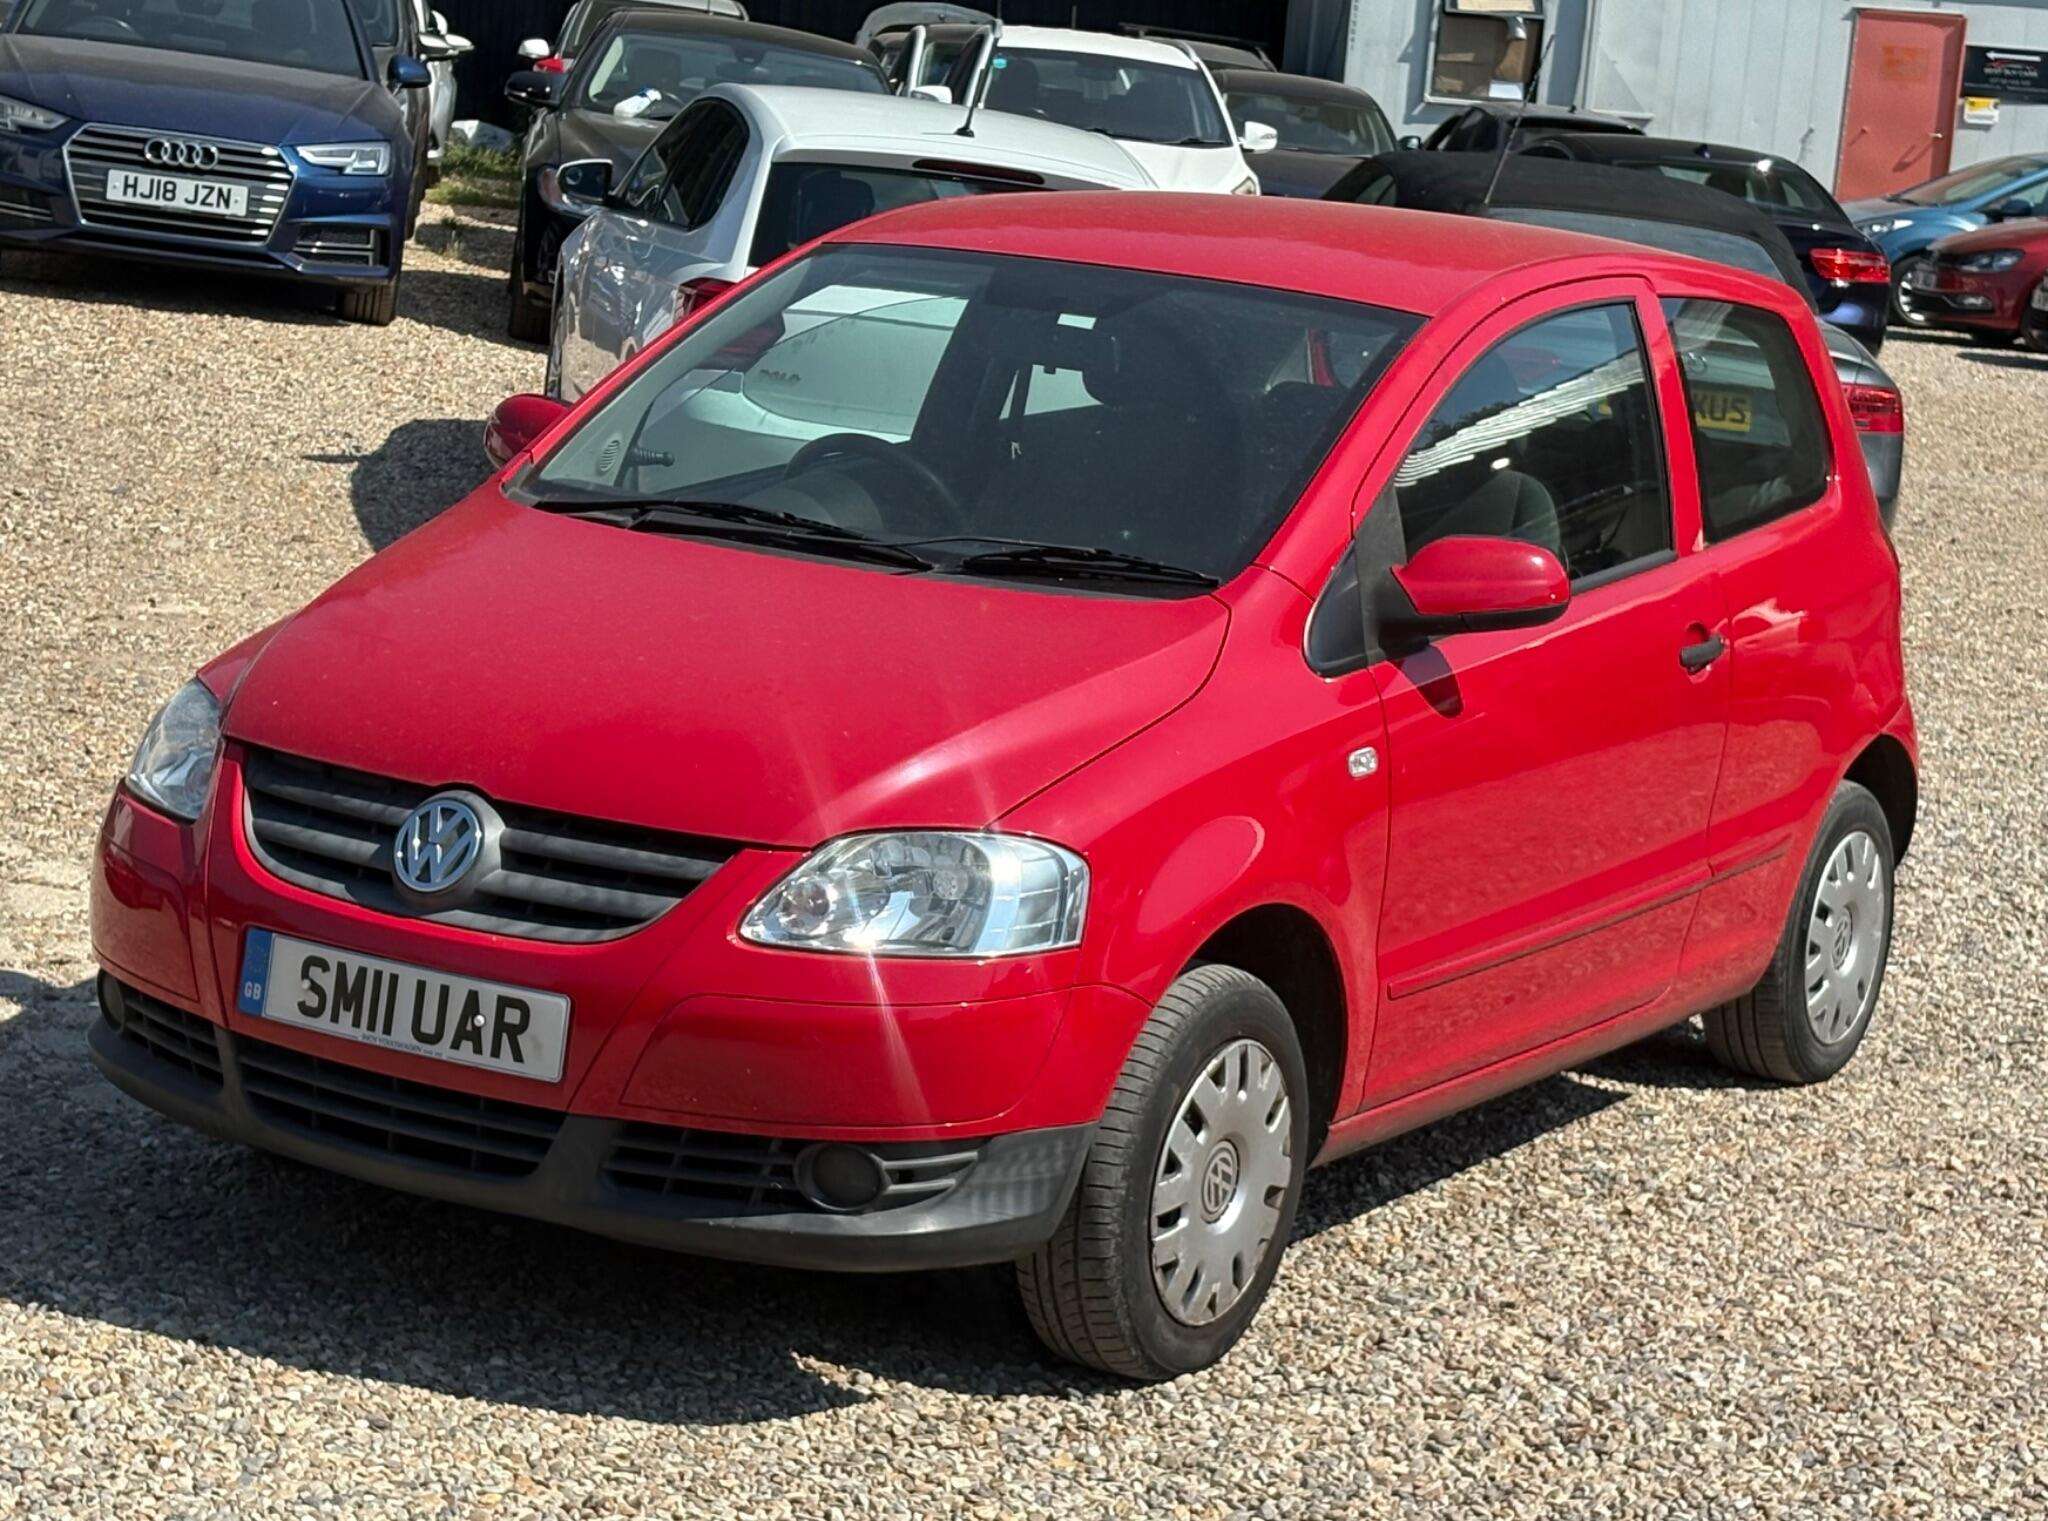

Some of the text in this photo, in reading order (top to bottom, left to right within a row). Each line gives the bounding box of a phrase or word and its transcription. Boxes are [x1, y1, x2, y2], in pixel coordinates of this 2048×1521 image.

[122, 174, 232, 210] HJ18 JZN
[244, 981, 262, 1000] GB
[297, 954, 531, 1065] SM11 UAR
